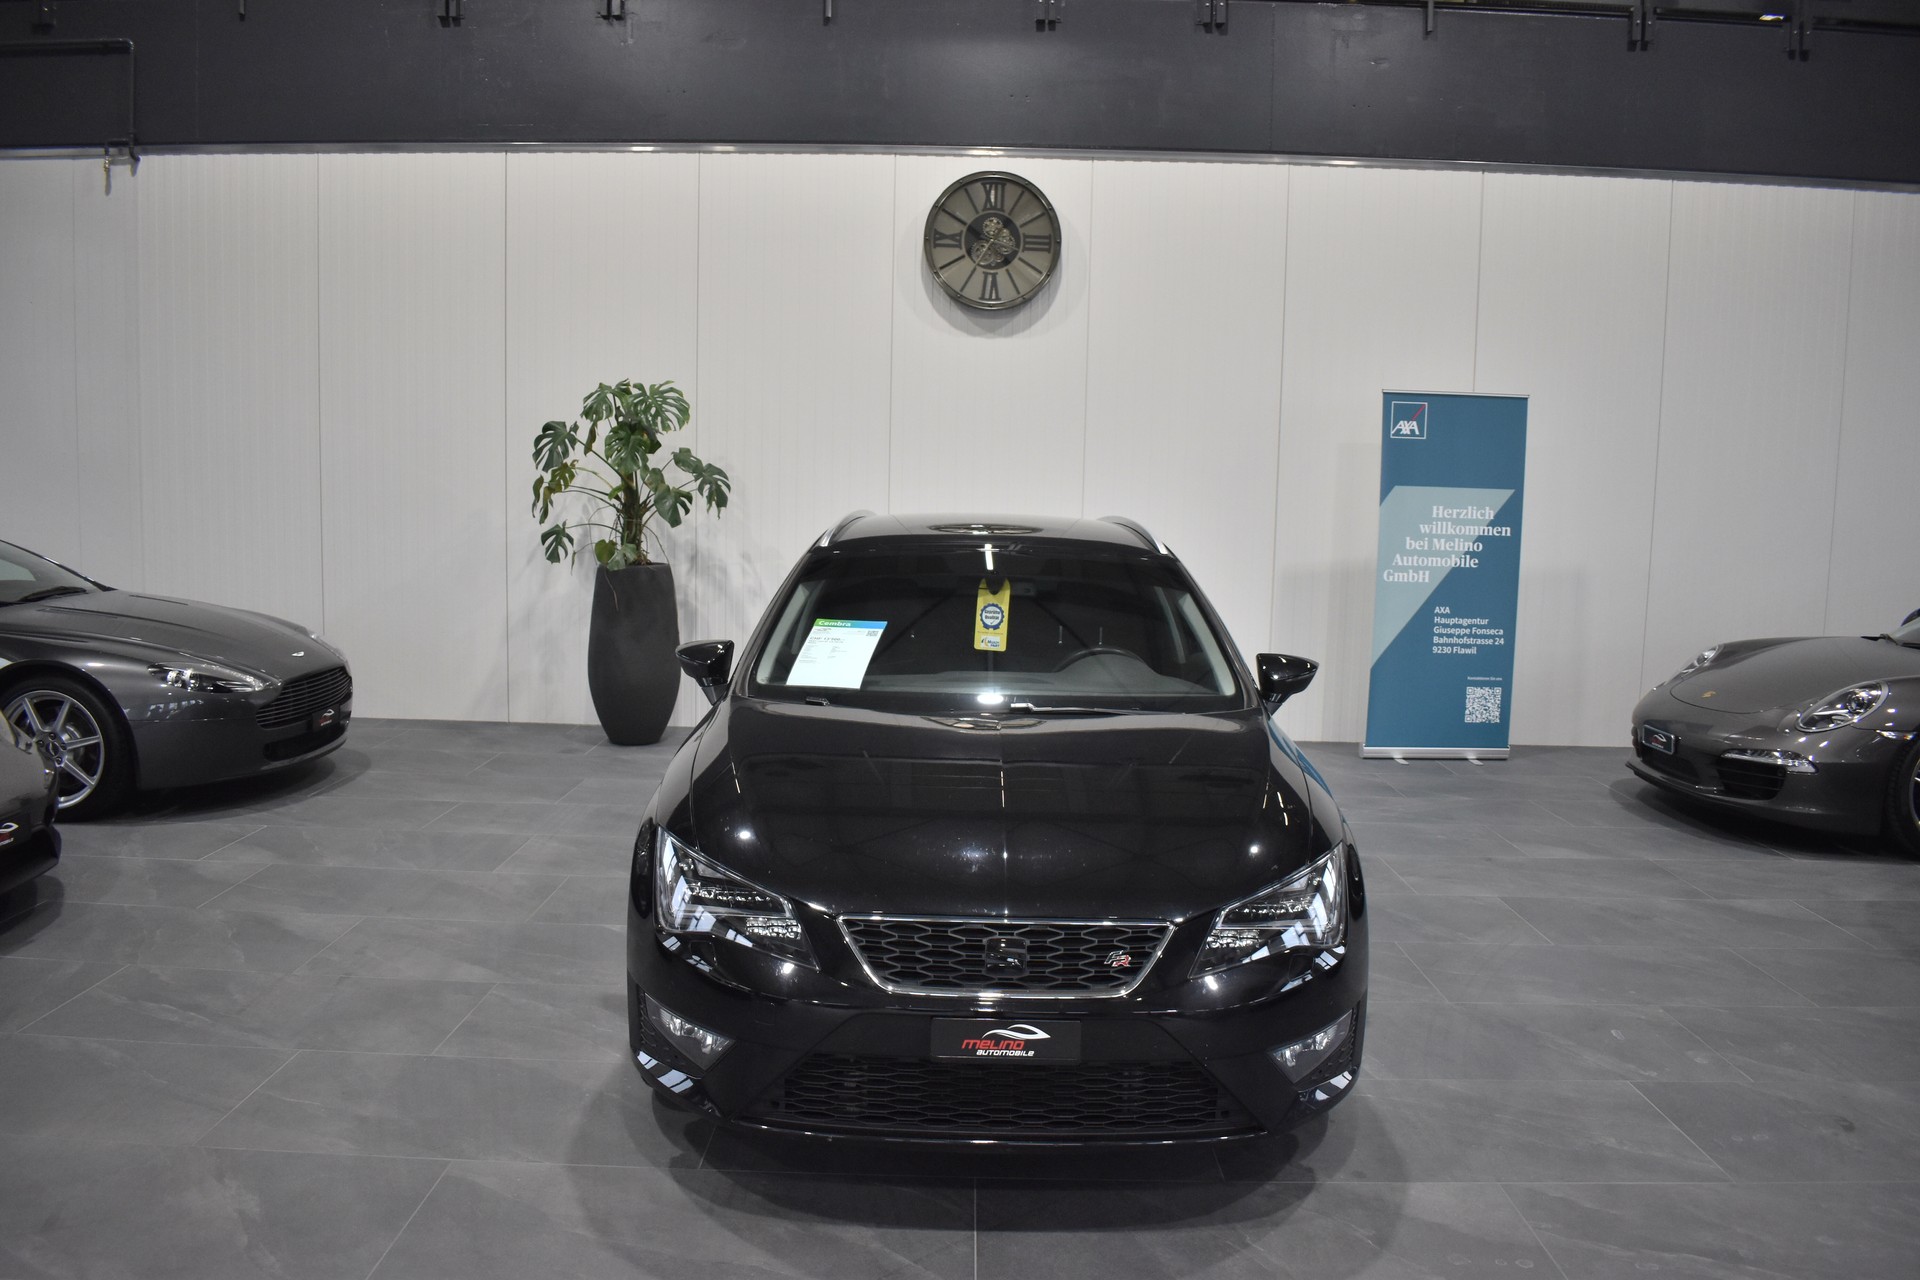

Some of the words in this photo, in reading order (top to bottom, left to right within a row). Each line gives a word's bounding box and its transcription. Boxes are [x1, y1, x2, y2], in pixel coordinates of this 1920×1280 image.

[981, 182, 1007, 212] XII
[1022, 233, 1052, 254] III
[1391, 420, 1420, 435] AXA
[1432, 505, 1494, 520] Herzlich
[1419, 521, 1511, 537] willkommen
[1406, 537, 1428, 550] bei
[1432, 538, 1483, 552] Melino
[1392, 553, 1479, 568] Automobile
[1383, 569, 1430, 583] GmbH
[1434, 606, 1450, 614] AXA
[1434, 616, 1489, 626] Hauptagentur
[1433, 626, 1470, 636] Giuseppe
[1472, 627, 1503, 635] Fonseca
[1433, 636, 1493, 645] Bahnhofstrasse
[1494, 637, 1504, 645] 24
[1432, 646, 1451, 654] 9230
[1453, 646, 1477, 655] Flawil
